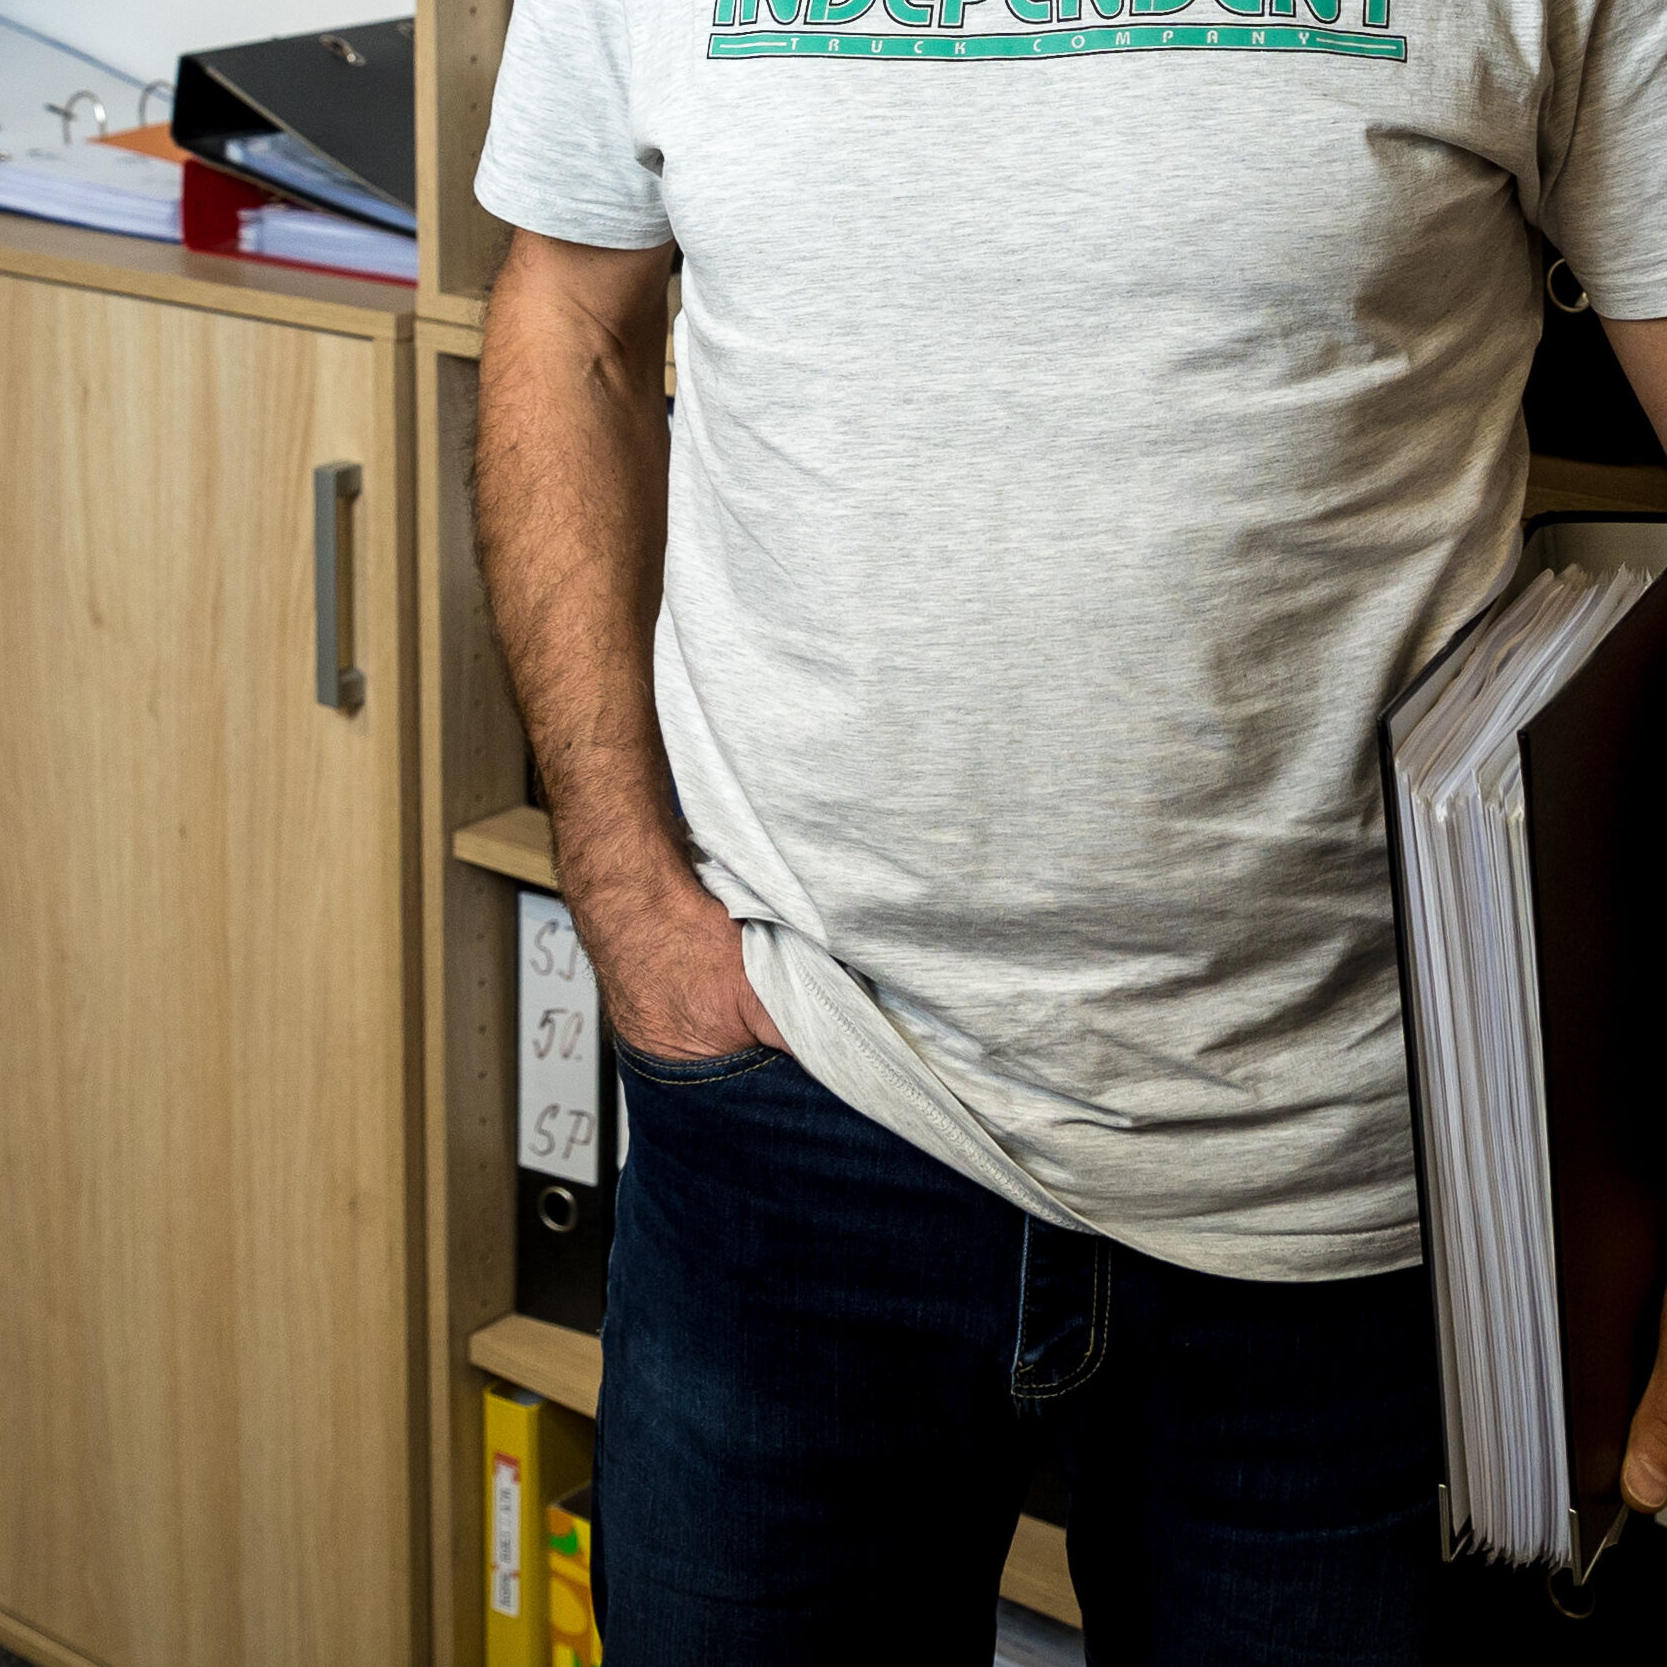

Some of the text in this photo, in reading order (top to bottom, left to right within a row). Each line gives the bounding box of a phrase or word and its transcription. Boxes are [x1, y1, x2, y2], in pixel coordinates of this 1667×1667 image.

[786, 29, 1311, 56] TRUCK COMPANY
[532, 1008, 583, 1060] 50.
[529, 1102, 596, 1160] SP
